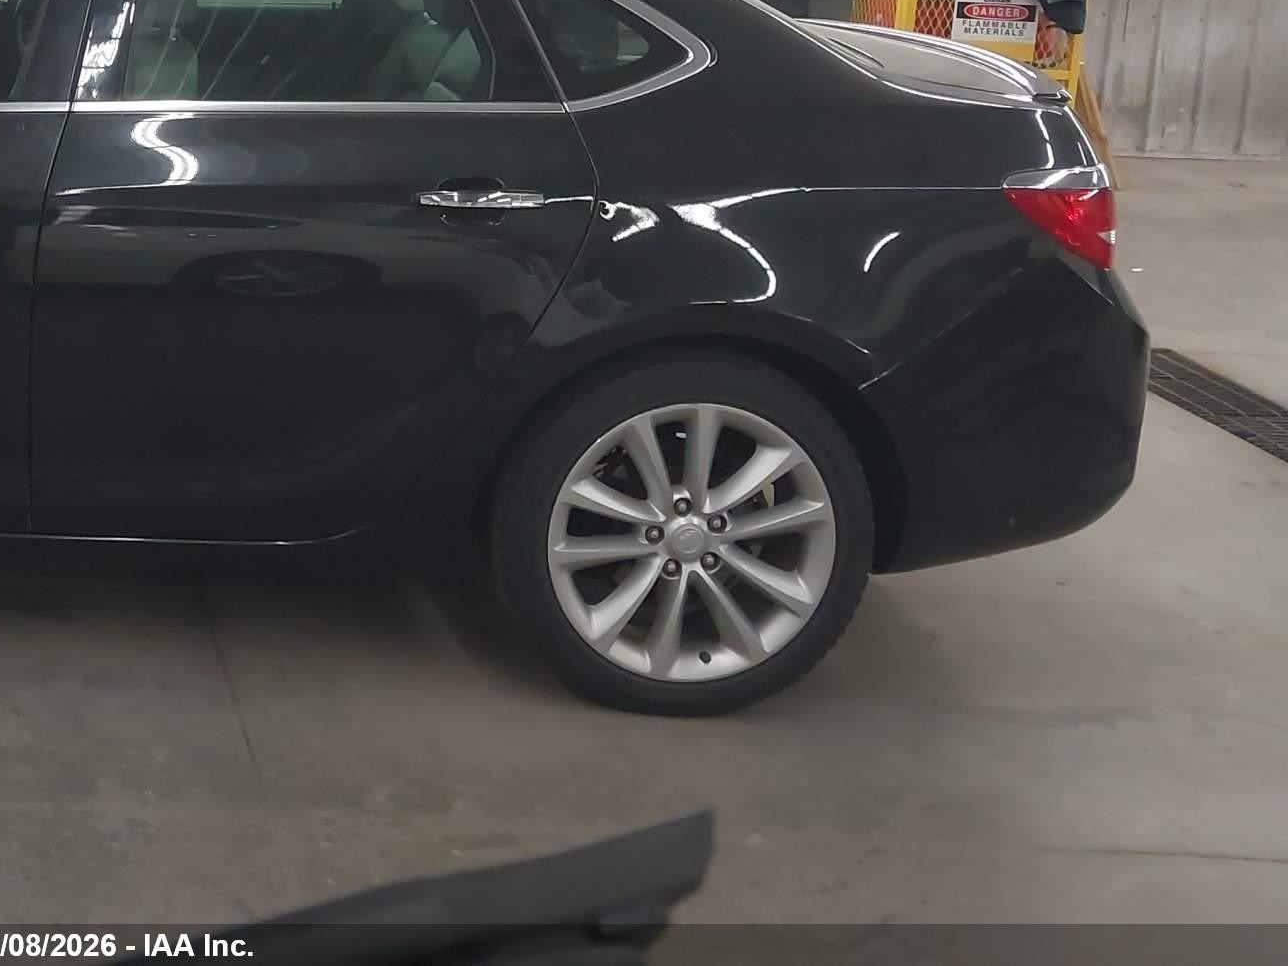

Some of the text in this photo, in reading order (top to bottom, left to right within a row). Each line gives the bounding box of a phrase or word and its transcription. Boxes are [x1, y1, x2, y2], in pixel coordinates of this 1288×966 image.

[971, 6, 1021, 18] DANGER
[962, 19, 1028, 29] FLAMMABLE
[964, 27, 1024, 36] MATERIALS
